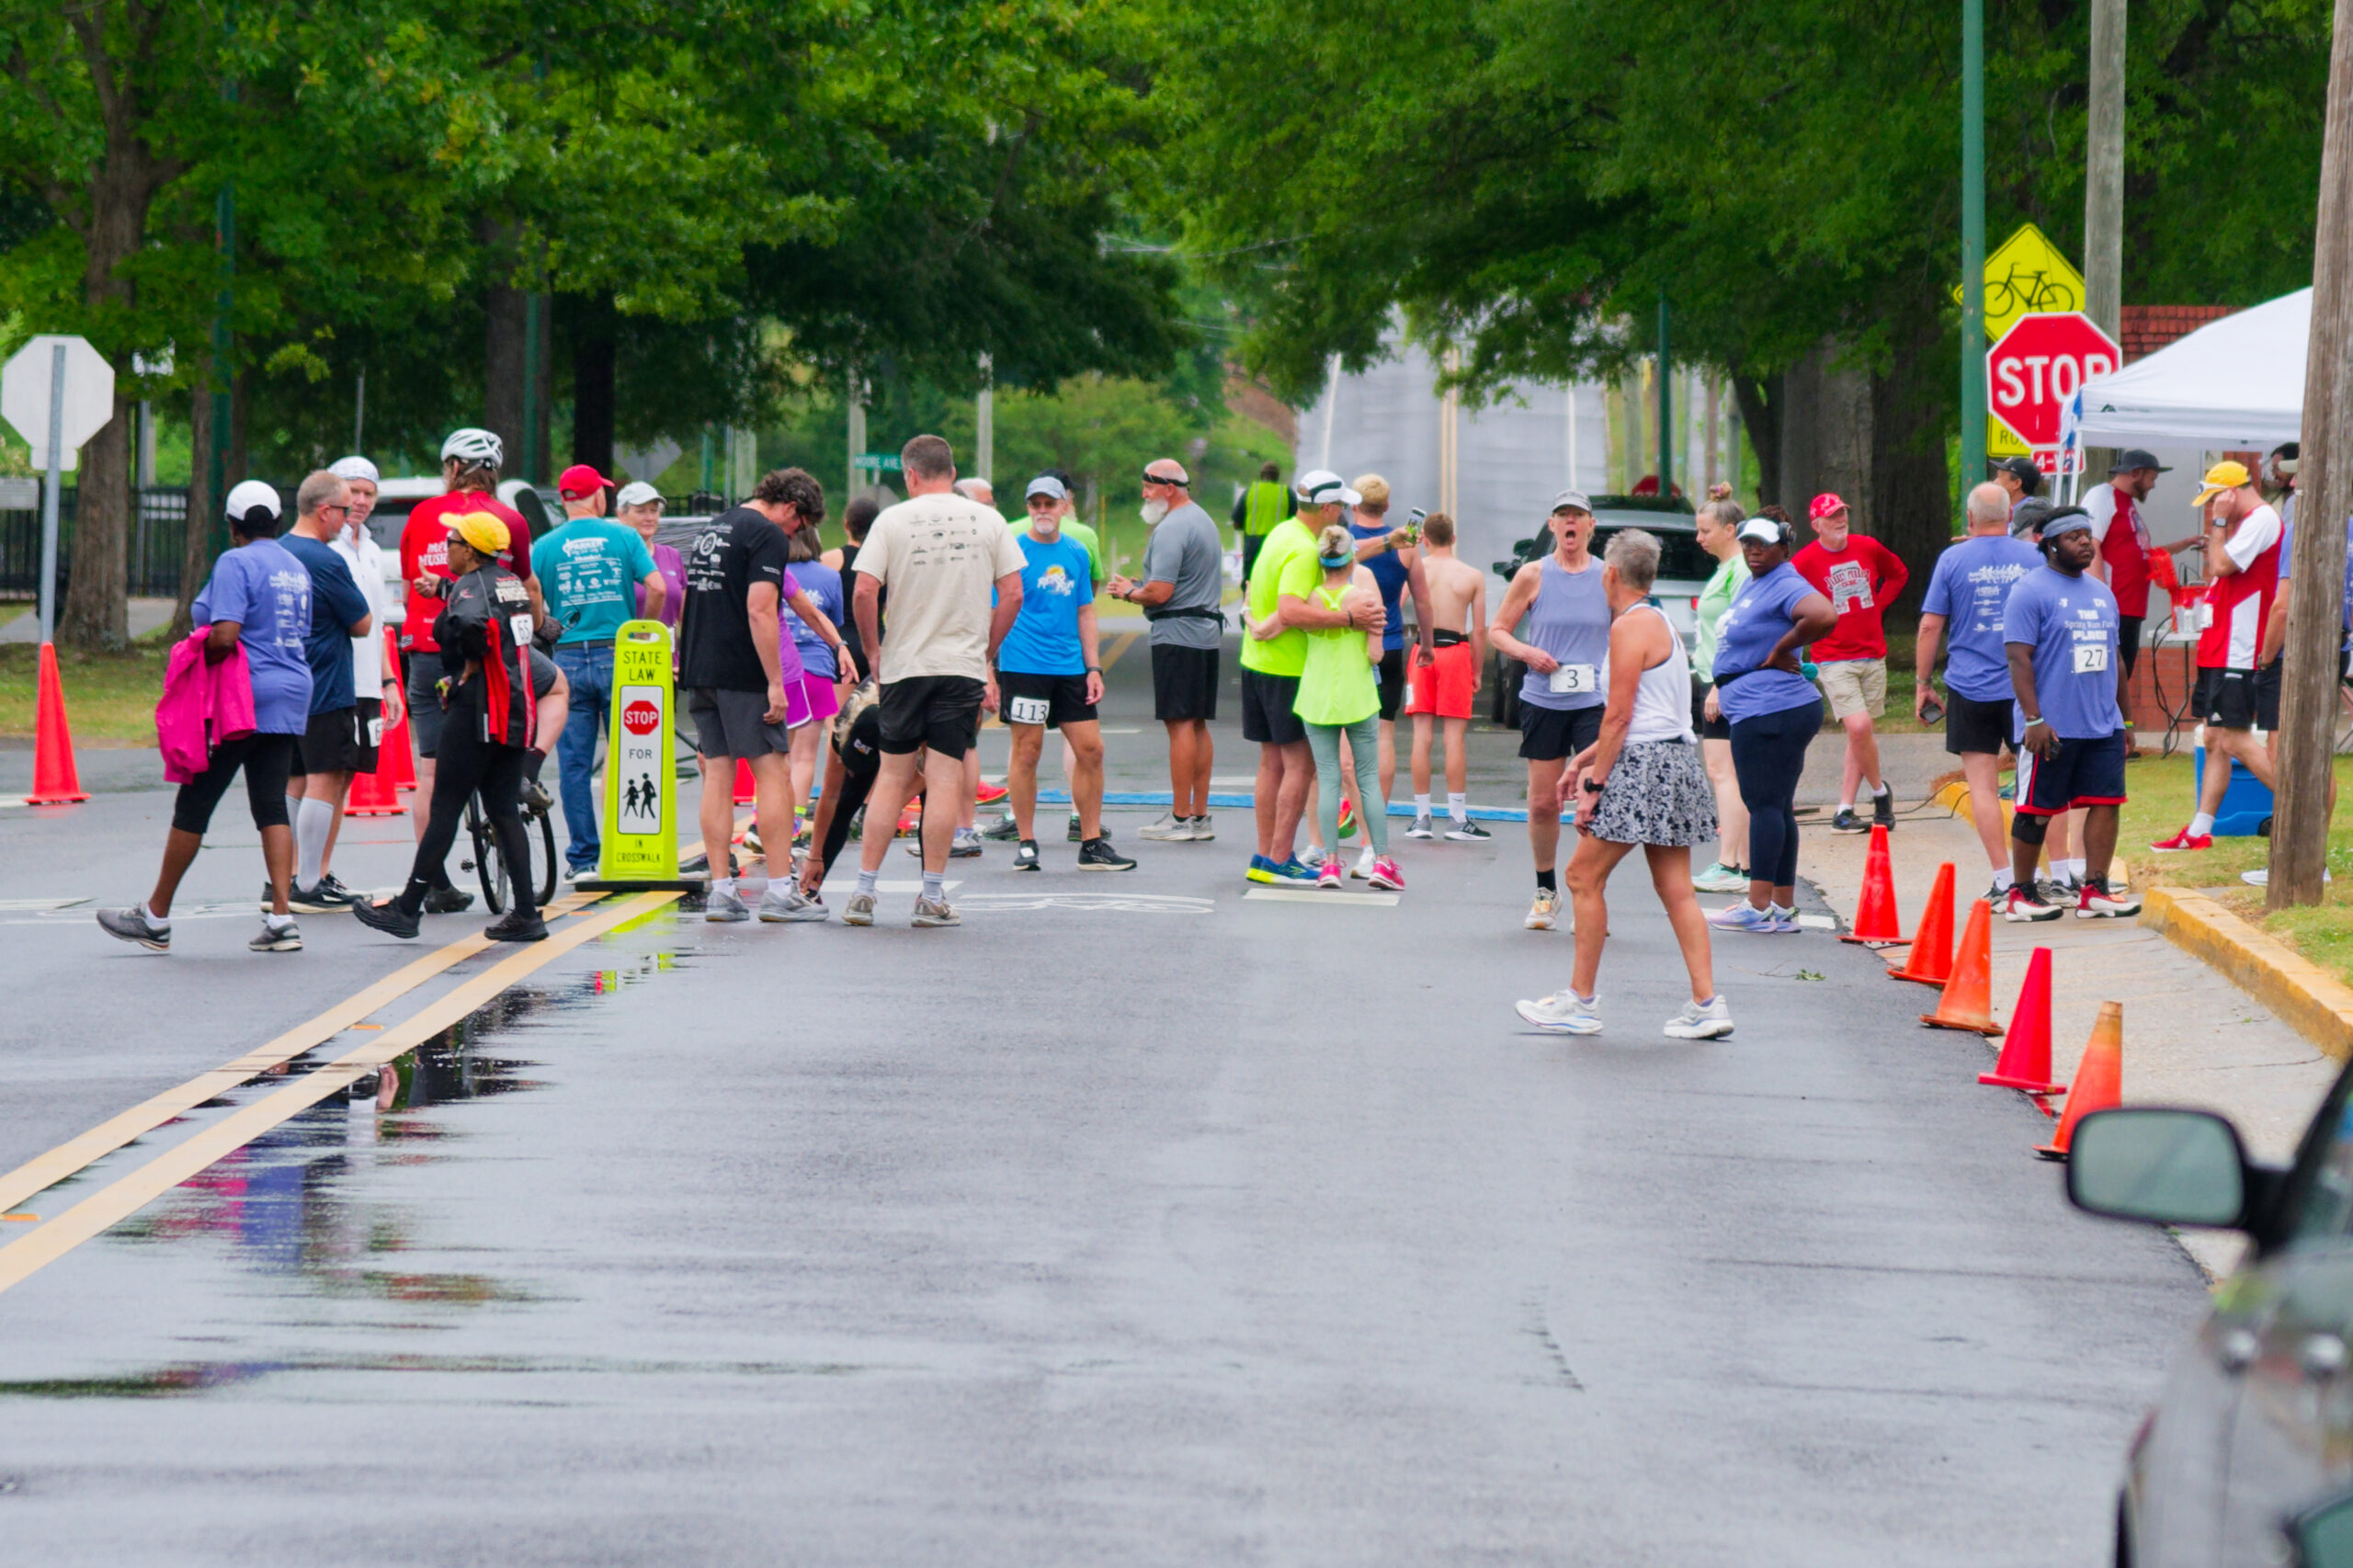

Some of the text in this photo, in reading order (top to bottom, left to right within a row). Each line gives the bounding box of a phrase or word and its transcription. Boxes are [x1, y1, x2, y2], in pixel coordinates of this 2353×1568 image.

[1997, 354, 2112, 407] STOP
[623, 651, 663, 665] STATE
[2083, 649, 2104, 667] 27
[629, 668, 655, 681] LAW
[1566, 668, 1579, 688] 3
[625, 710, 658, 725] STOP
[1015, 702, 1049, 722] 113
[629, 749, 653, 759] FOR
[634, 837, 643, 848] IN
[617, 852, 662, 862] CROSSWALK
